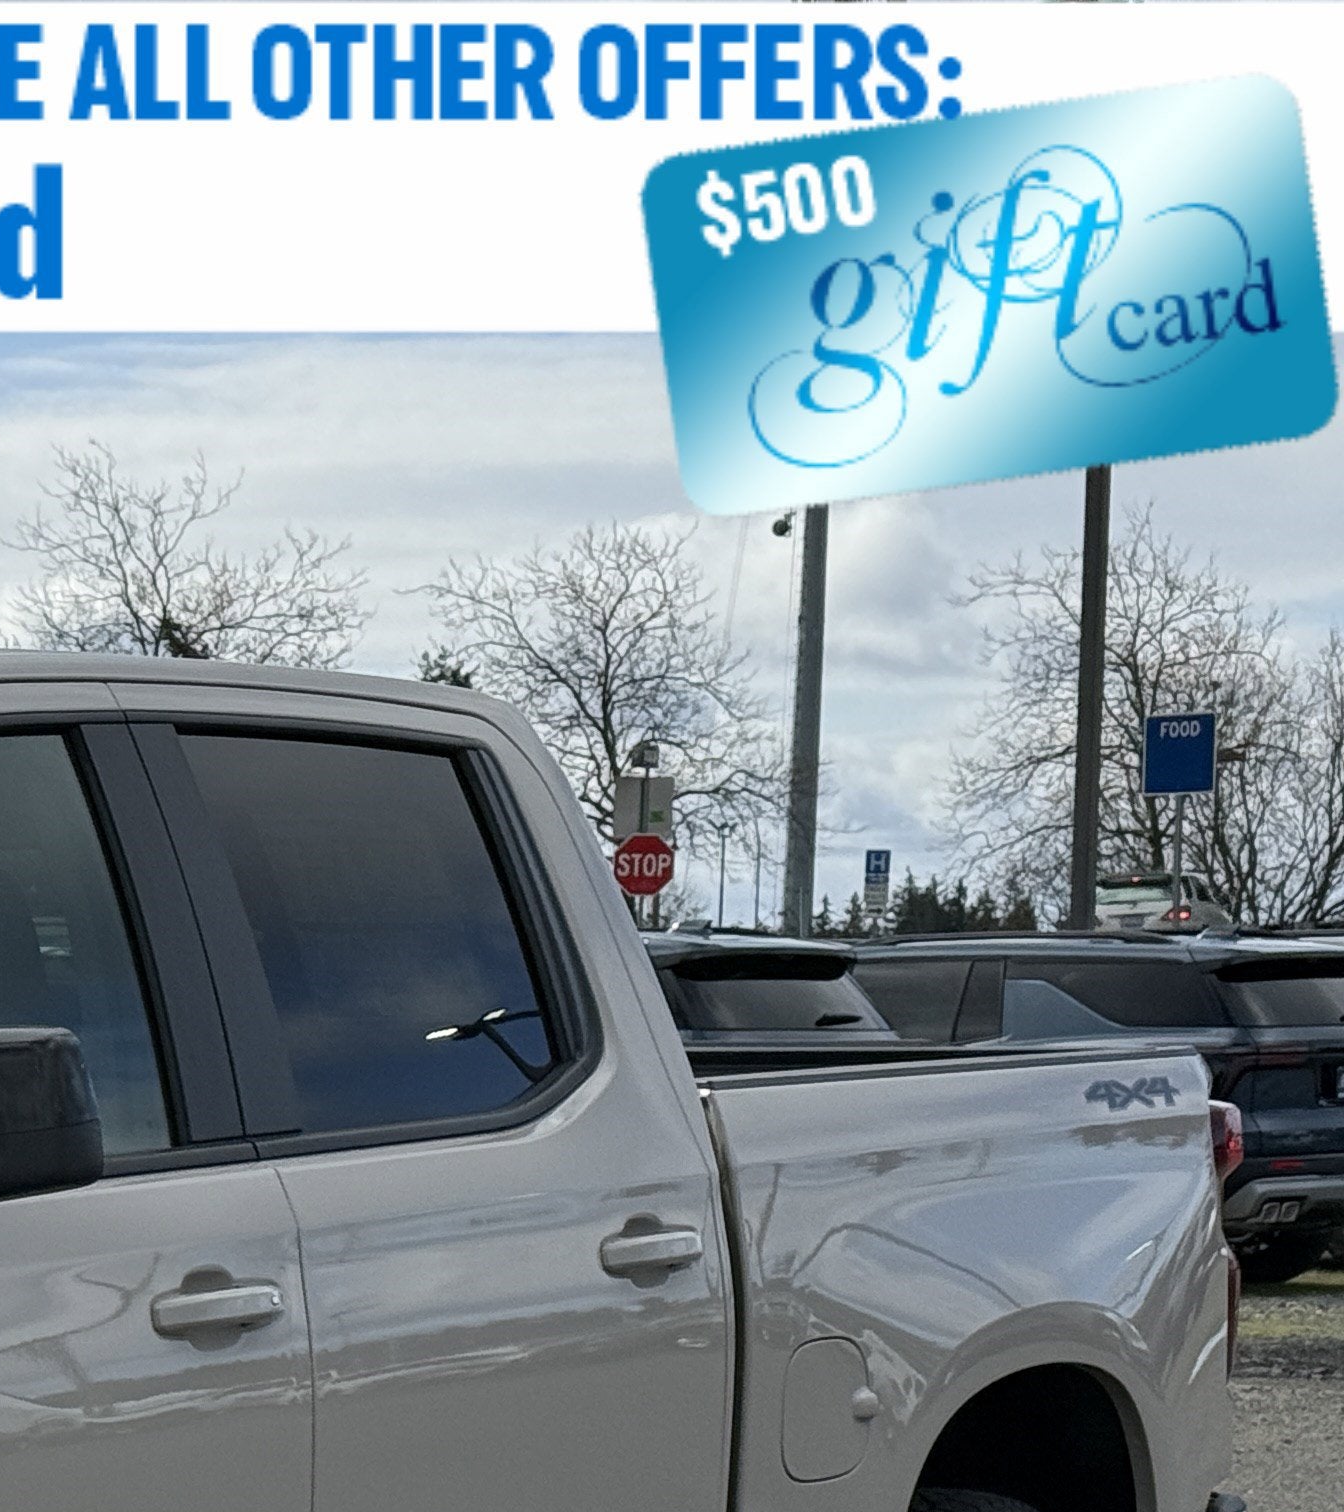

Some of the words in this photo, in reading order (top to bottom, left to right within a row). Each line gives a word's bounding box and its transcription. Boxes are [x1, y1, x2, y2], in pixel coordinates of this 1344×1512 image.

[1160, 720, 1201, 738] FOOD
[617, 853, 671, 877] STOP
[870, 856, 887, 872] H
